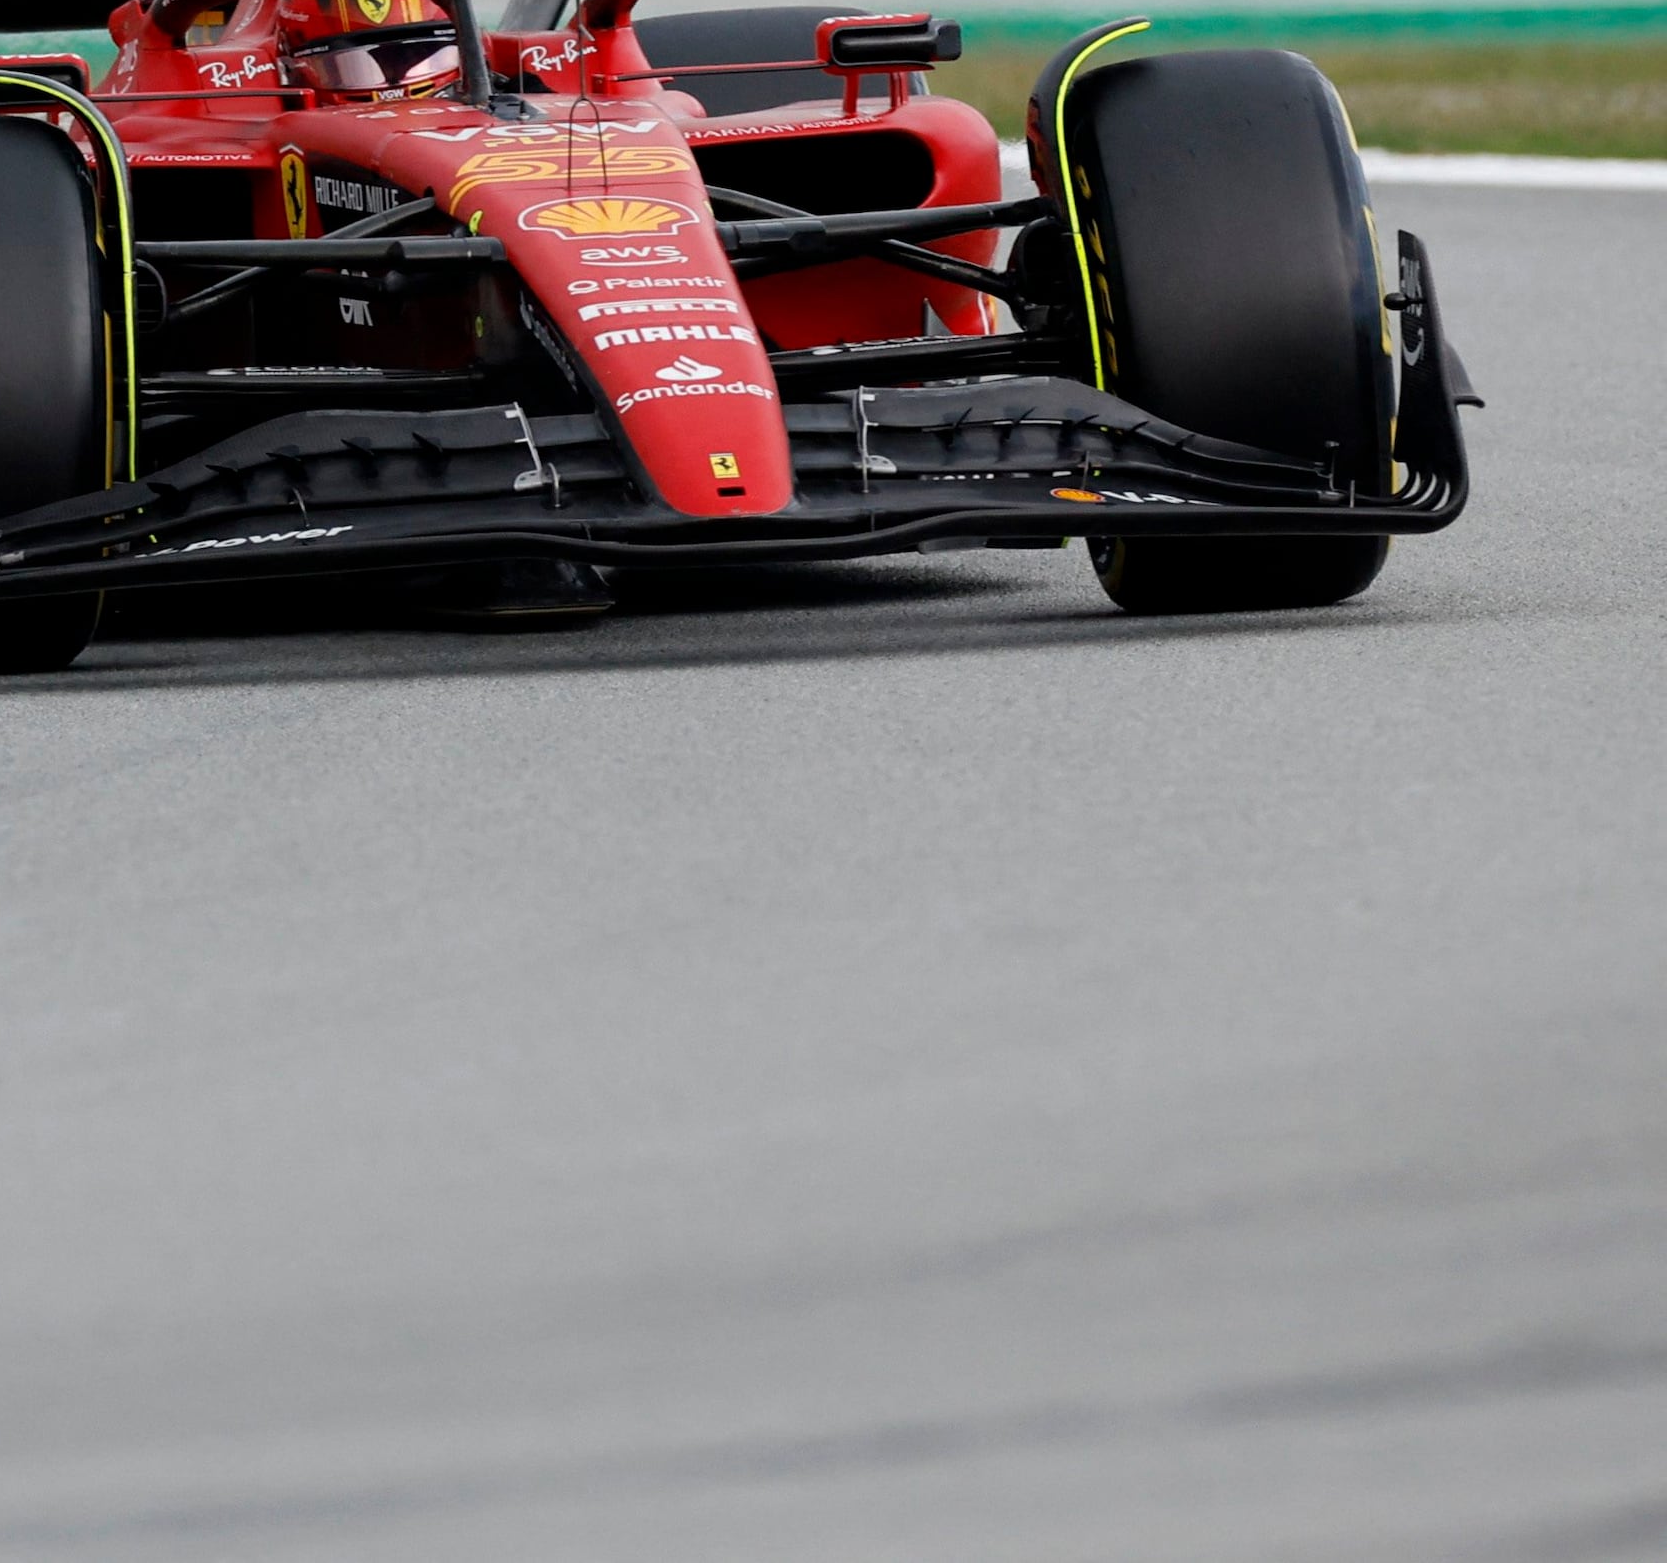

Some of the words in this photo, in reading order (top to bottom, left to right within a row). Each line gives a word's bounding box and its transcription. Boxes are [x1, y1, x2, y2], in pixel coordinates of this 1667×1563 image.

[198, 55, 275, 88] Ray-Ban
[379, 88, 405, 100] VGW
[411, 121, 662, 143] VGW
[482, 132, 618, 148] PLAY
[683, 123, 796, 139] HARMAN
[143, 153, 253, 163] AUTOMOTIVE
[453, 146, 693, 181] 55
[315, 175, 364, 211] RICHARD
[365, 184, 399, 214] MILLE
[579, 244, 683, 261] aws
[604, 275, 728, 290] Palantir
[578, 297, 739, 322] PIRELLI
[594, 325, 757, 351] MAHLE
[615, 381, 775, 414] Santander
